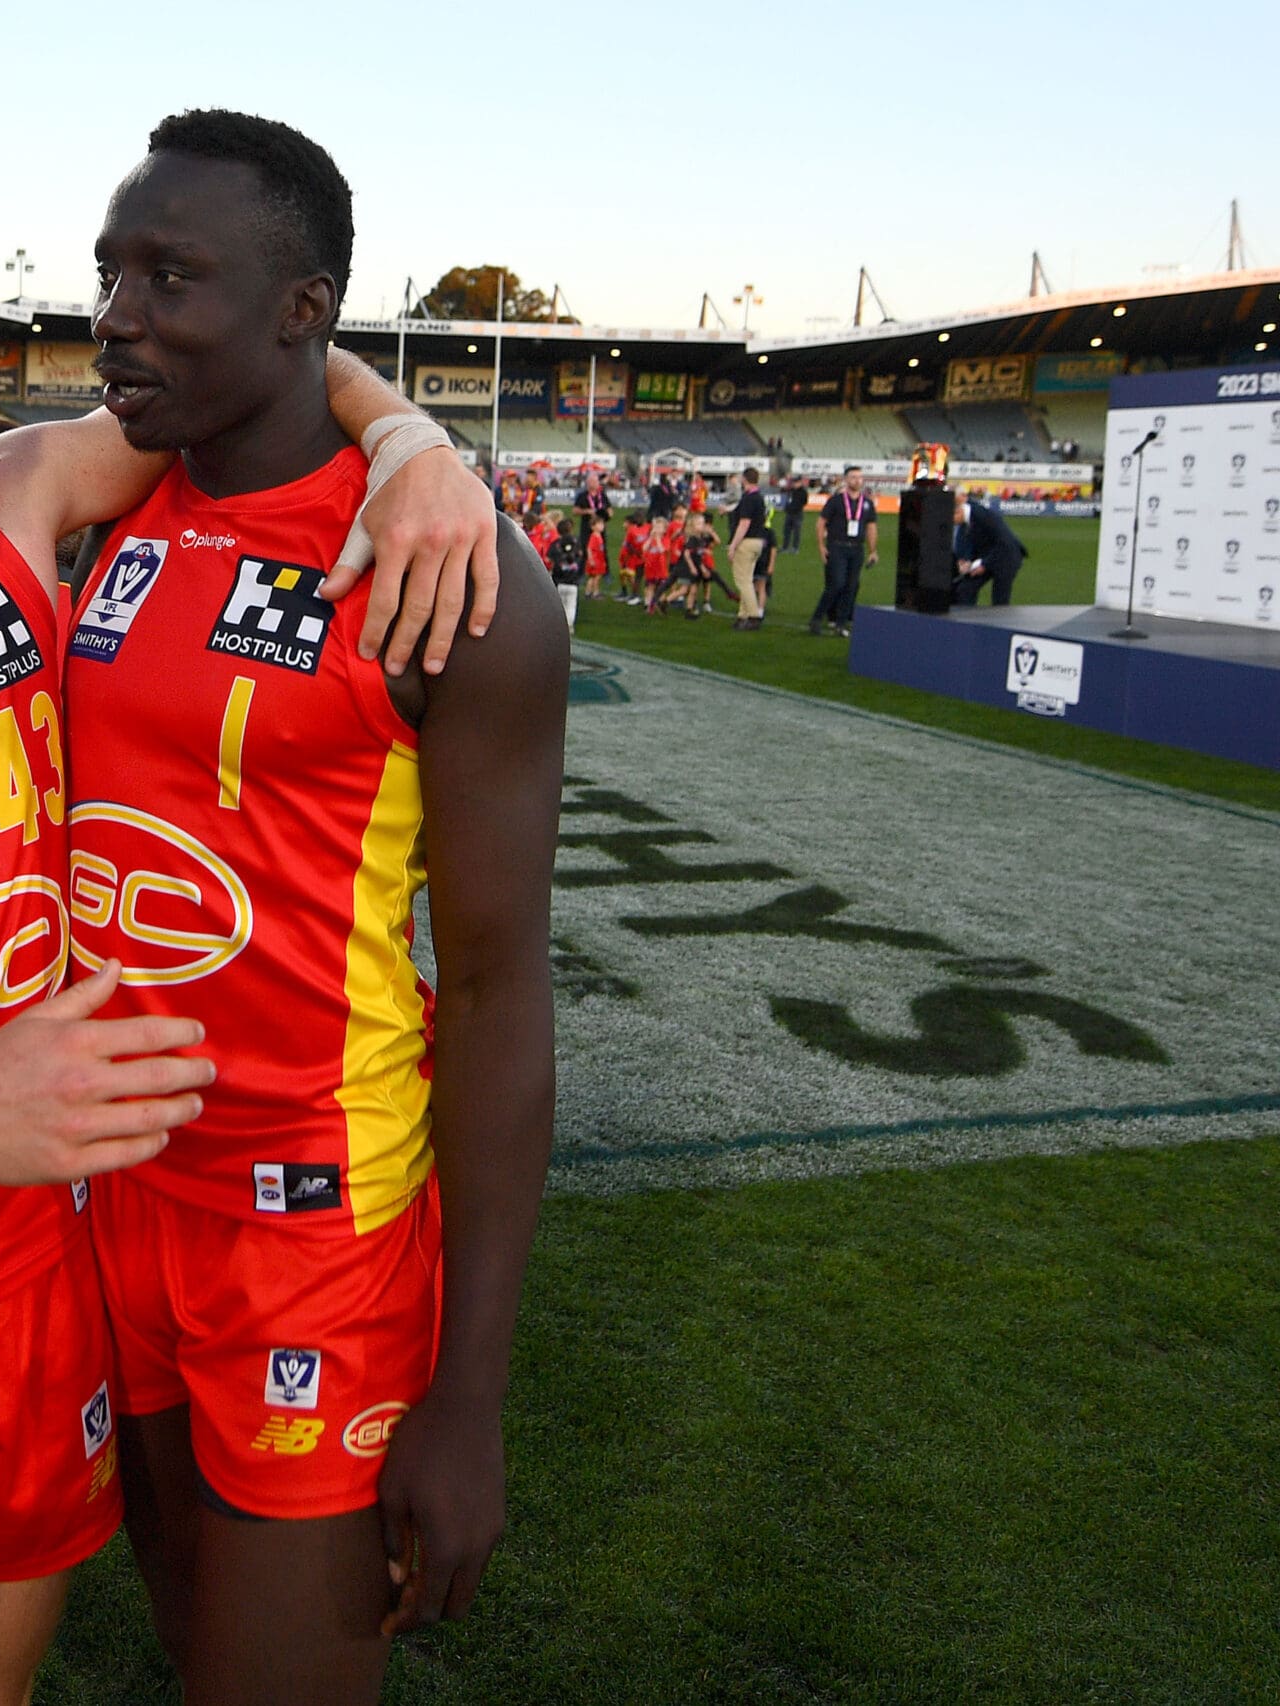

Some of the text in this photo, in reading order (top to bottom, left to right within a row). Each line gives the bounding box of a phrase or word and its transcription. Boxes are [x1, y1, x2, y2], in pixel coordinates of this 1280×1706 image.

[340, 319, 392, 331] GENDS
[448, 377, 545, 397] IKON PARK
[1218, 373, 1259, 397] 2023
[135, 545, 152, 557] AFL
[194, 533, 236, 551] plungie
[103, 601, 118, 613] VFL
[73, 632, 119, 652] SMITHY'S
[211, 629, 315, 671] HOSTPLUS
[217, 674, 256, 811] 1
[69, 849, 212, 952] GC
[250, 1416, 326, 1456] NB
